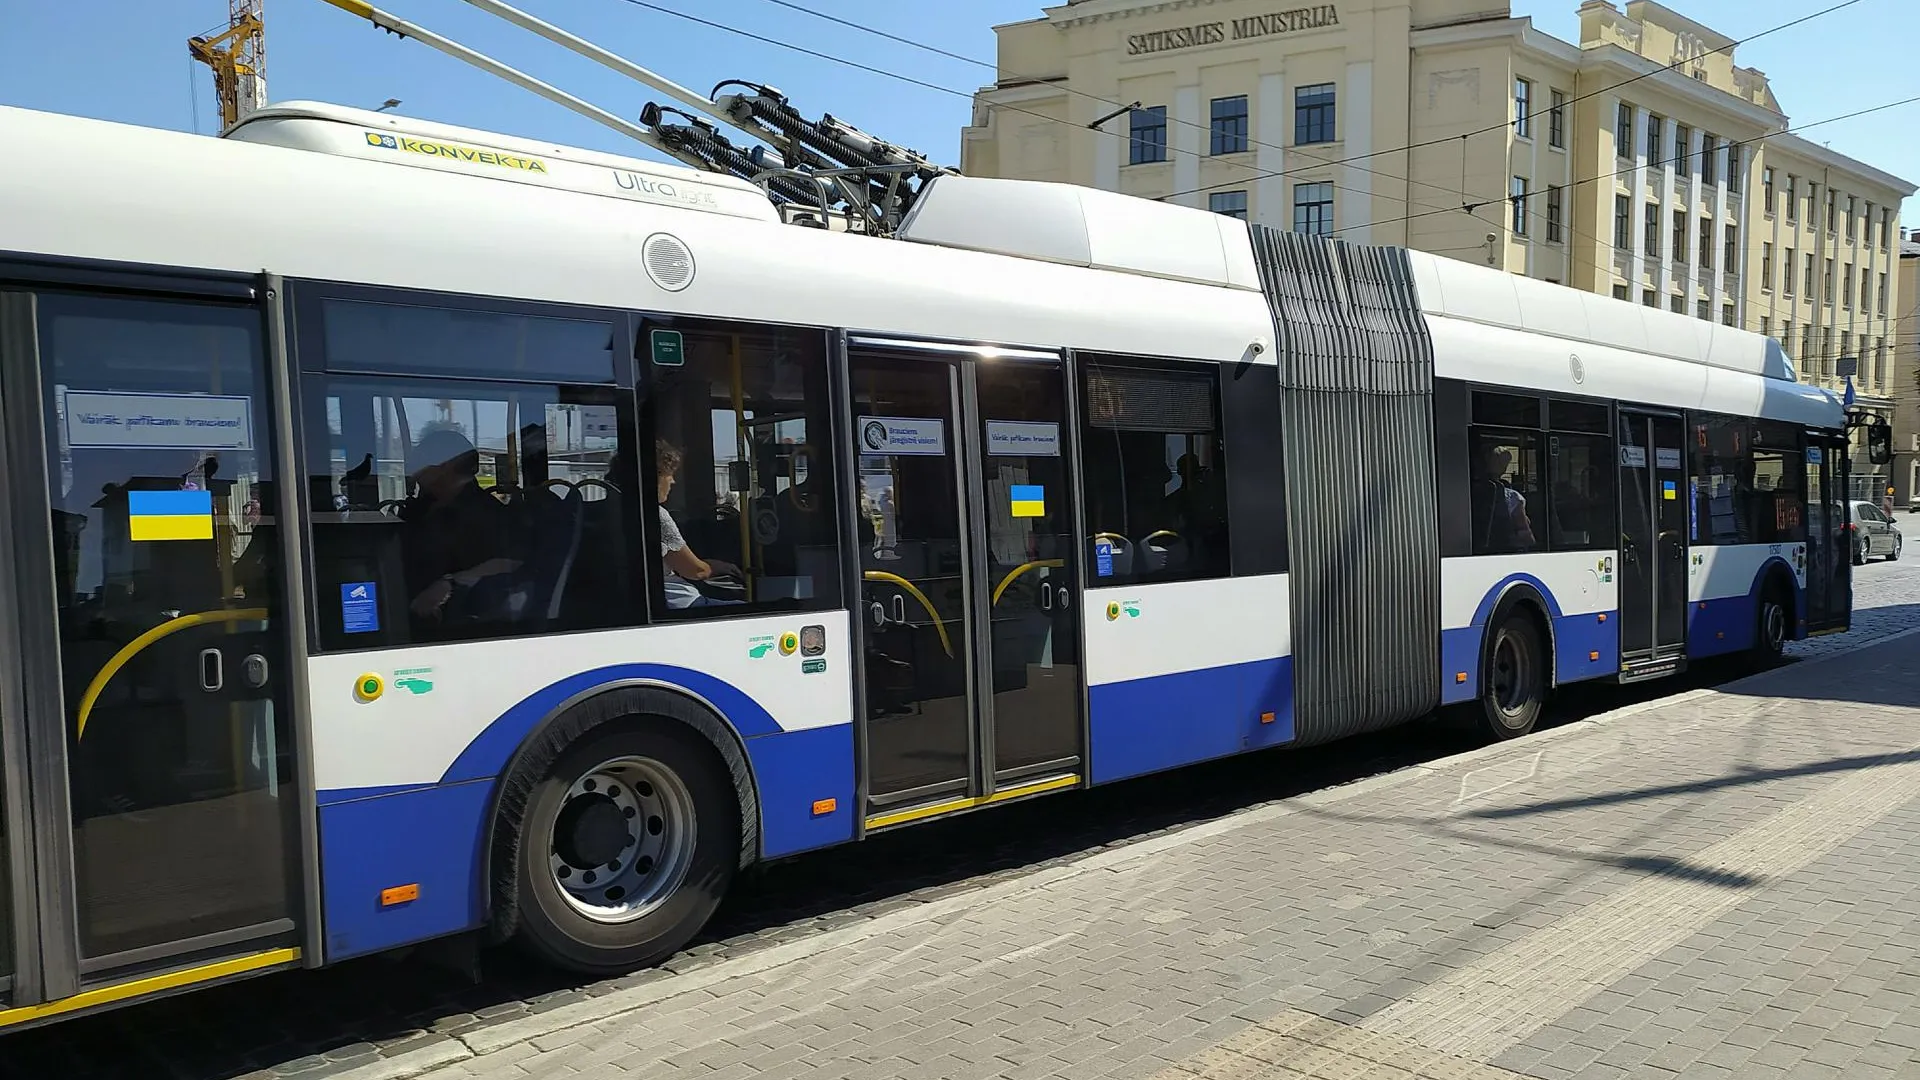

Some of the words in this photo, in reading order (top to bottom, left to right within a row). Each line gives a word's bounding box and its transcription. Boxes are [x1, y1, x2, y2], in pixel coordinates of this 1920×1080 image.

[1127, 21, 1225, 55] SATIKSMES
[1231, 4, 1340, 40] MINISTRIJA
[400, 137, 546, 173] KONVEKTA
[613, 171, 677, 197] Ultra
